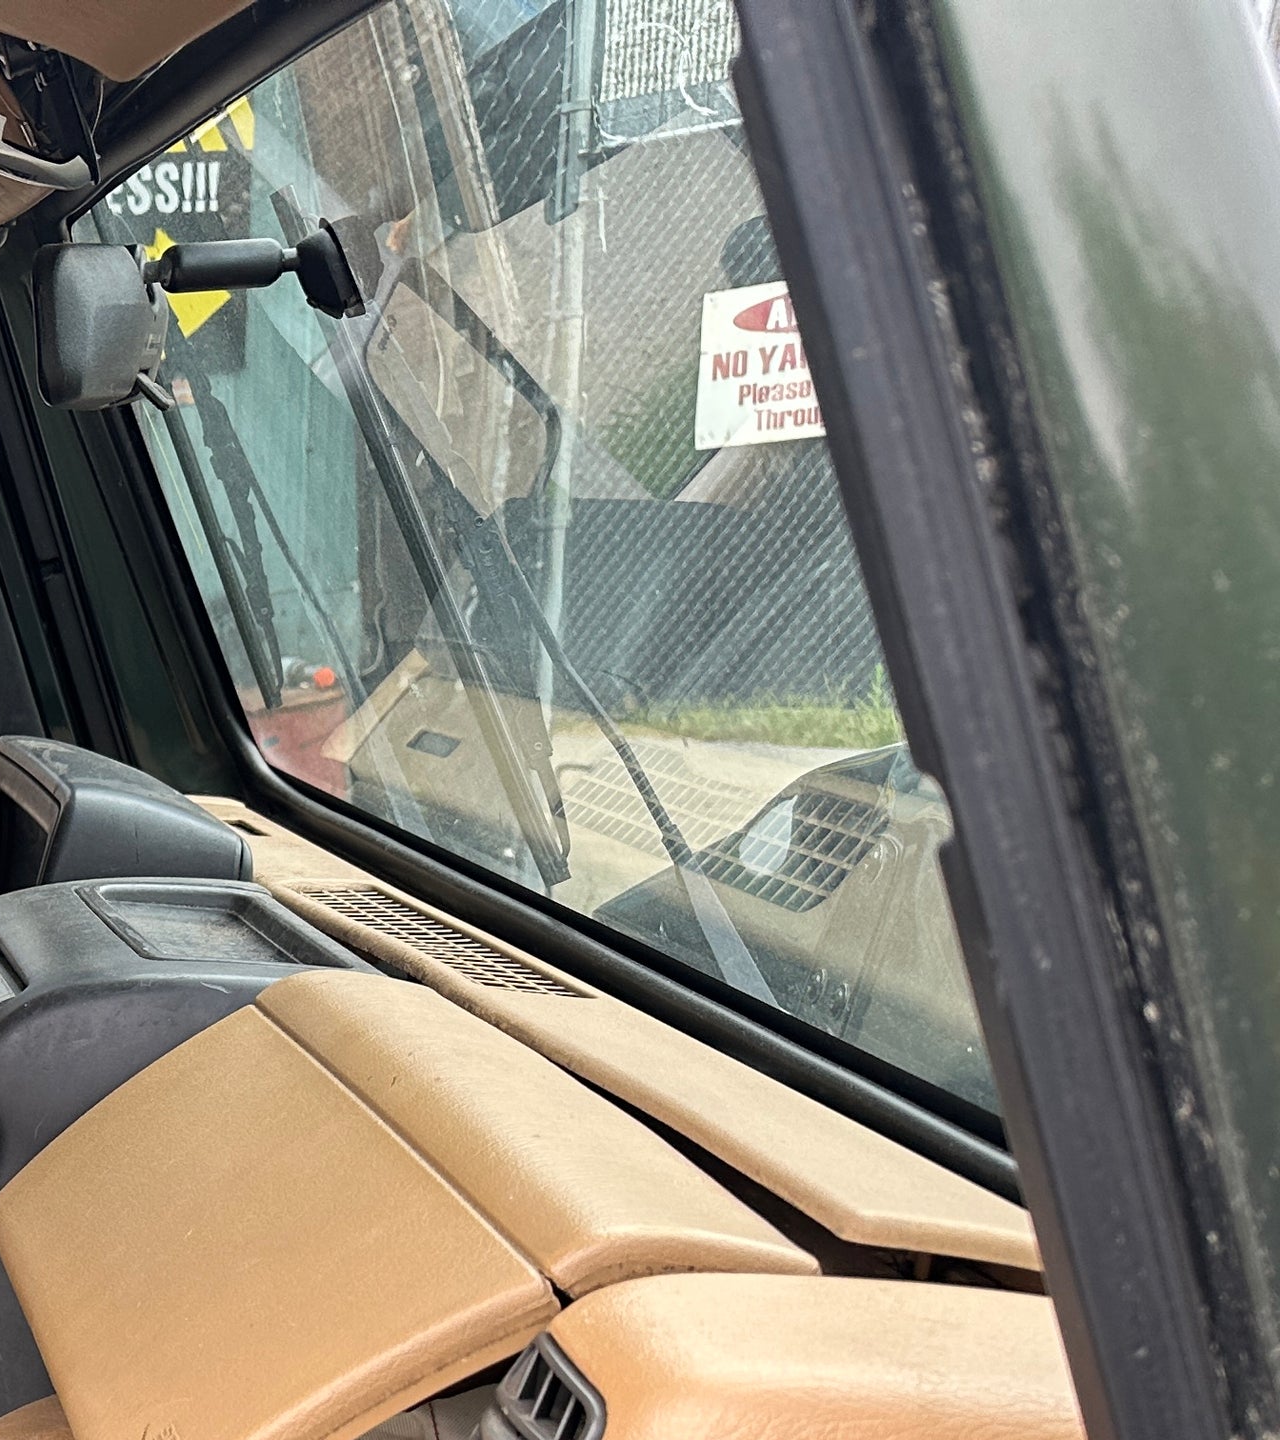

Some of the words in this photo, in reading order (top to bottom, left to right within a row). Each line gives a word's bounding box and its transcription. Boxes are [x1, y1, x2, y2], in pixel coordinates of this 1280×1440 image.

[765, 297, 798, 331] A
[712, 350, 749, 381] NO
[738, 380, 812, 406] Please
[754, 405, 825, 431] Throu
